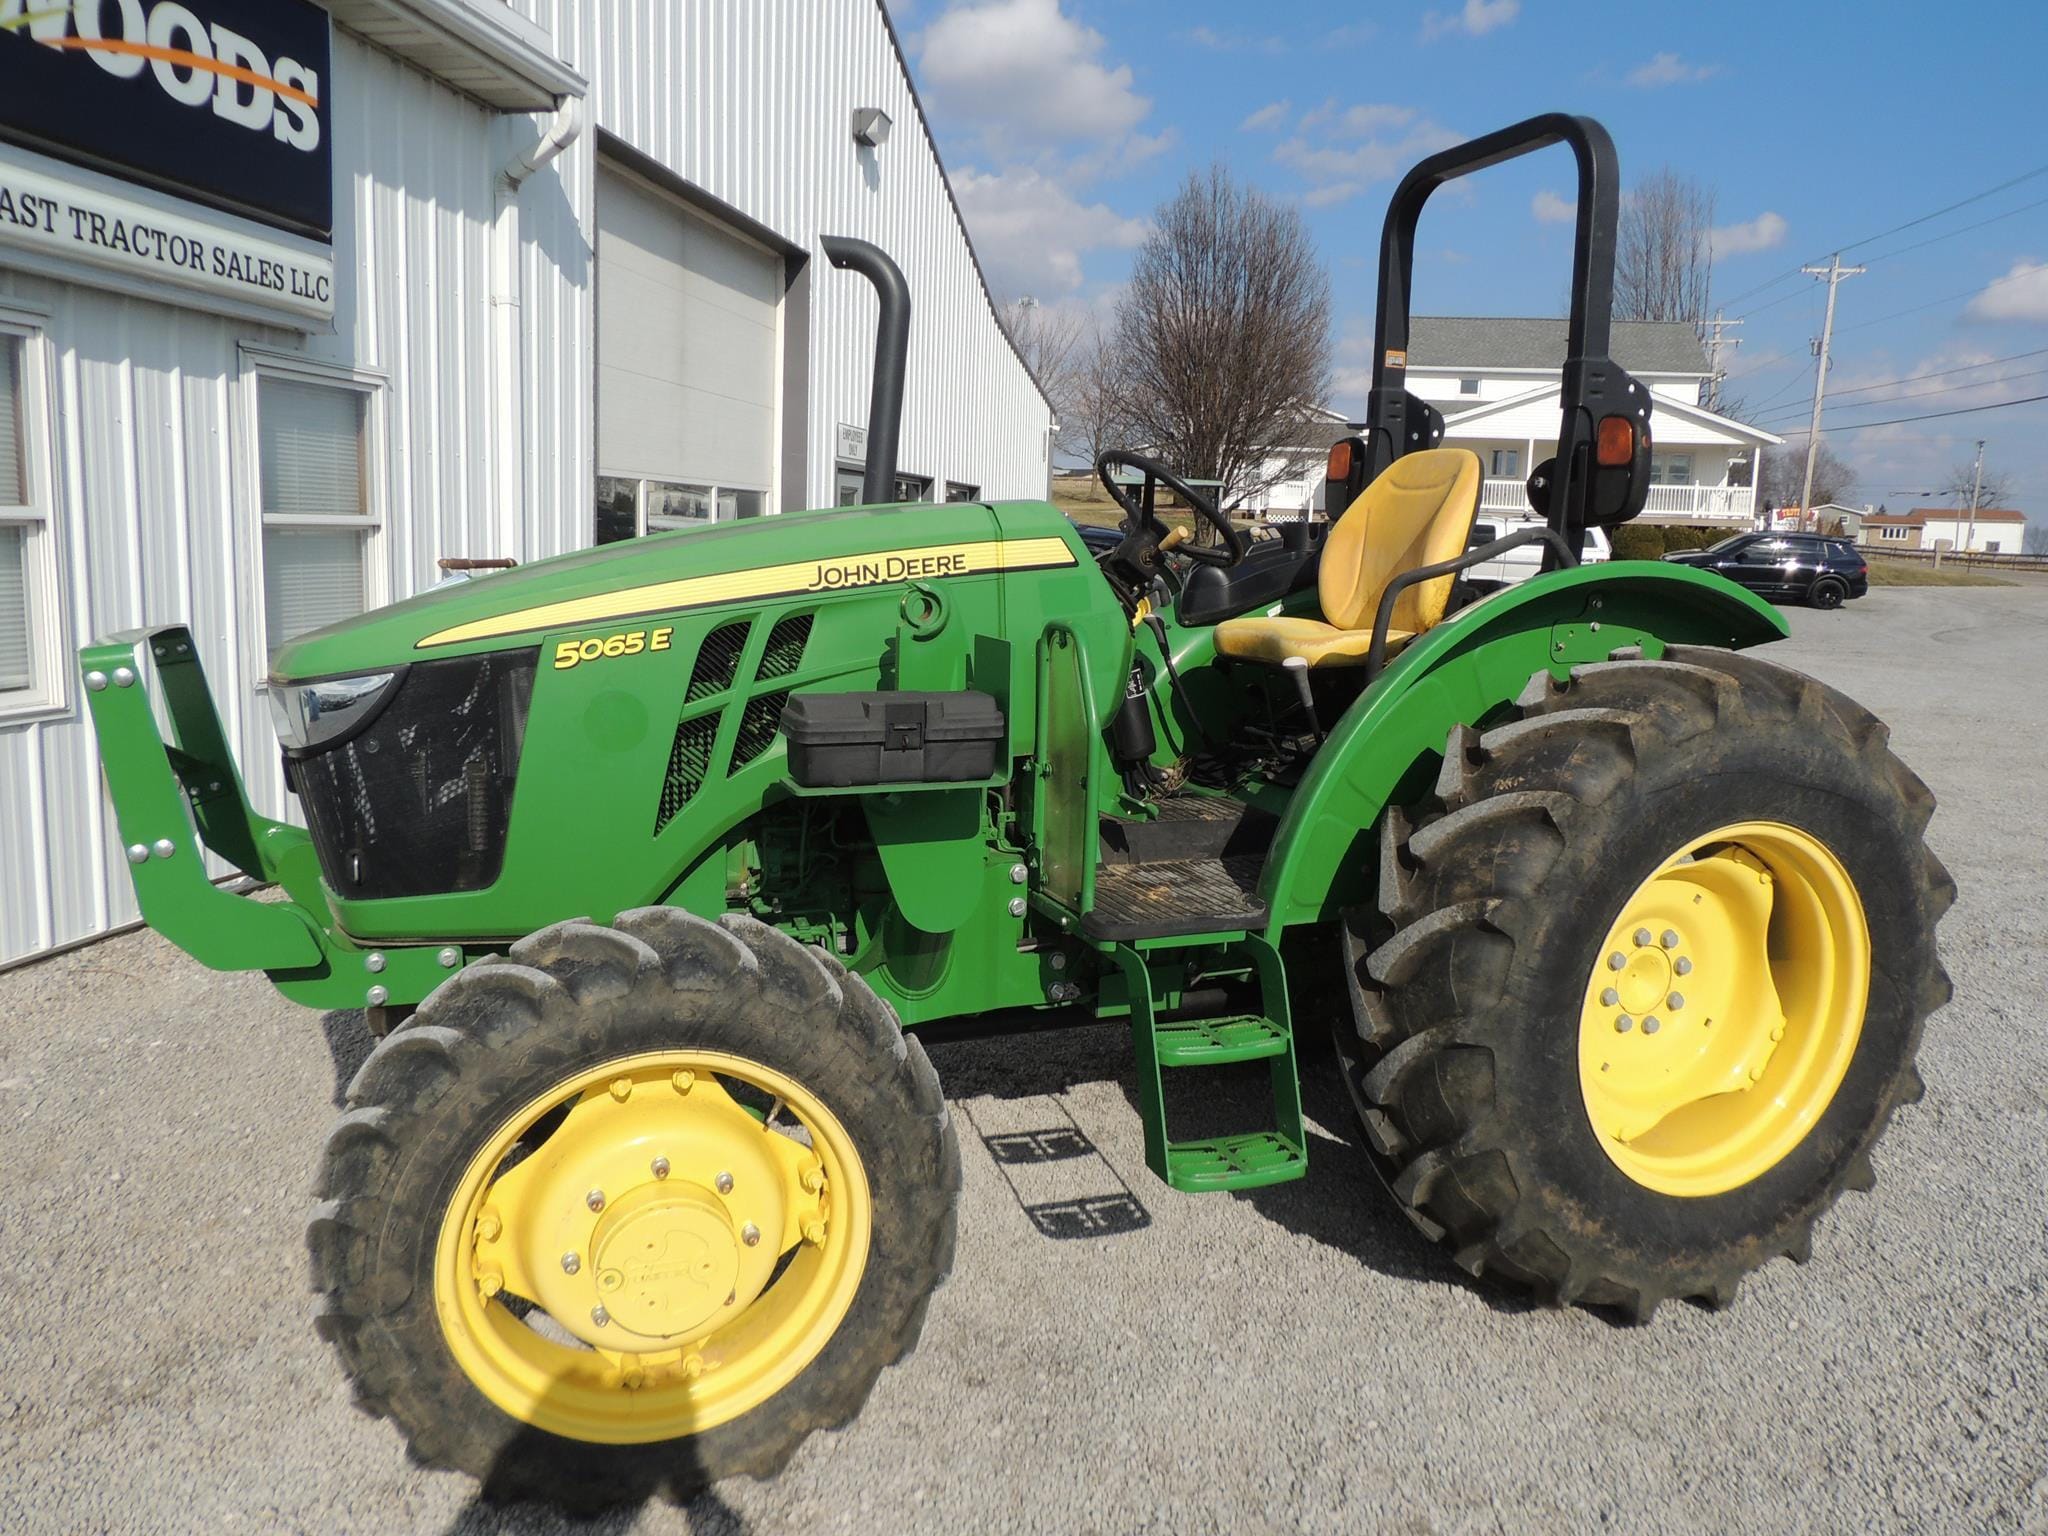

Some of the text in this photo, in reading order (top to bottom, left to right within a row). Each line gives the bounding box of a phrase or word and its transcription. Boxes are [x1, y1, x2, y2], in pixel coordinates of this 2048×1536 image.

[68, 206, 206, 272] TRACTOR
[213, 247, 285, 292] SALES
[290, 267, 330, 302] LLC
[808, 554, 966, 588] JOHN DEERE
[554, 627, 674, 670] 5065 E
